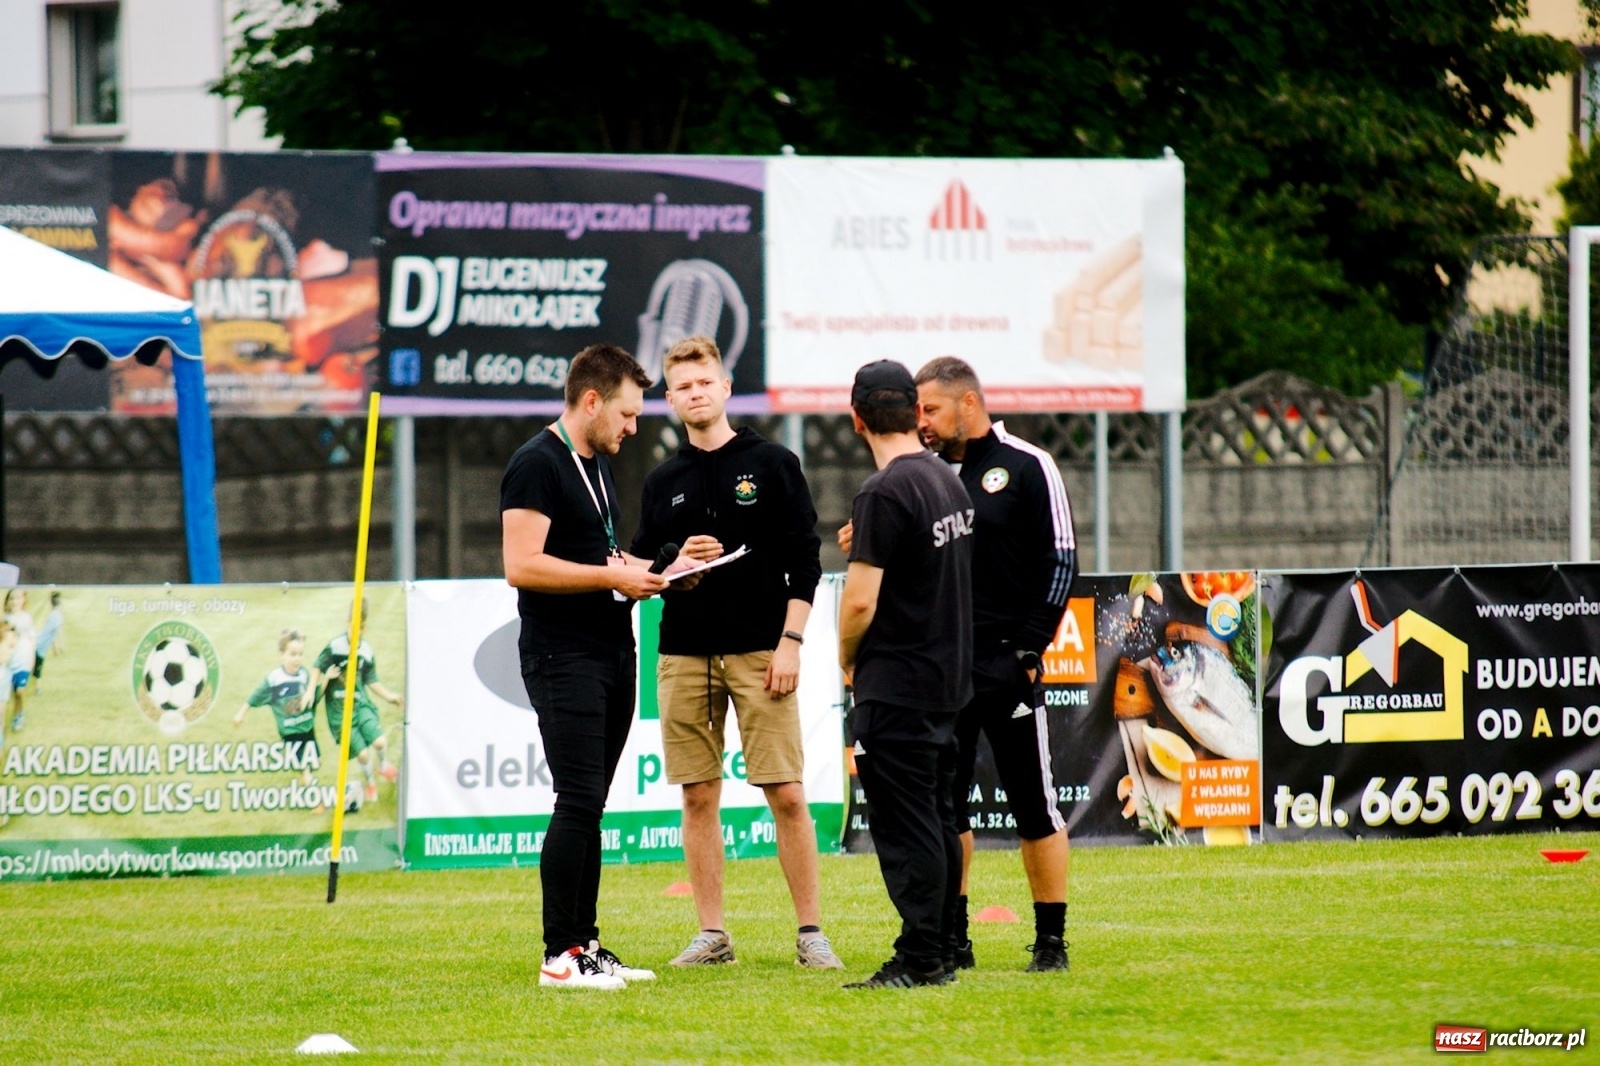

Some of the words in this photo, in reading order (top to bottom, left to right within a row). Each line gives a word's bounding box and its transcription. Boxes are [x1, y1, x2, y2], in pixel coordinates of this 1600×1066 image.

[389, 190, 506, 237] Oprawa
[509, 202, 650, 240] muzyczna
[653, 193, 751, 240] imprez
[12, 226, 98, 250] OWINA
[831, 217, 911, 251] ABIES
[461, 258, 608, 291] EUGENIUSZ
[387, 256, 460, 337] DJ
[457, 295, 602, 330] MIKOŁAJEK
[825, 314, 919, 336] specjalista
[923, 314, 944, 331] od
[949, 314, 1010, 332] drewna
[434, 349, 472, 384] tel.
[474, 353, 523, 385] 660
[524, 354, 569, 390] 623
[108, 597, 138, 614] liga,
[142, 596, 199, 614] turnieje,
[203, 597, 247, 614] obozy
[1476, 595, 1600, 622] www.gregorba
[1477, 708, 1523, 741] OD
[1531, 707, 1553, 738] A
[1562, 705, 1600, 738] DO
[4, 744, 163, 776] AKADEMIA
[168, 741, 320, 772] PIŁKARSKA
[457, 743, 547, 789] elek
[1188, 767, 1197, 781] U
[1199, 766, 1218, 779] NAS
[1221, 765, 1249, 779] RYBY
[144, 783, 221, 813] LKS-u
[227, 780, 339, 811] Tworków
[1075, 785, 1091, 802] 32
[1190, 785, 1198, 799] Z
[1199, 784, 1250, 799] WŁASNEJ
[1274, 774, 1349, 828] tel.
[1360, 775, 1450, 827] 665
[1460, 770, 1543, 824] 092
[968, 811, 985, 829] el.
[987, 812, 1003, 829] 32
[1193, 803, 1251, 819] WĘDZARNI
[424, 833, 513, 856] INSTALACJE
